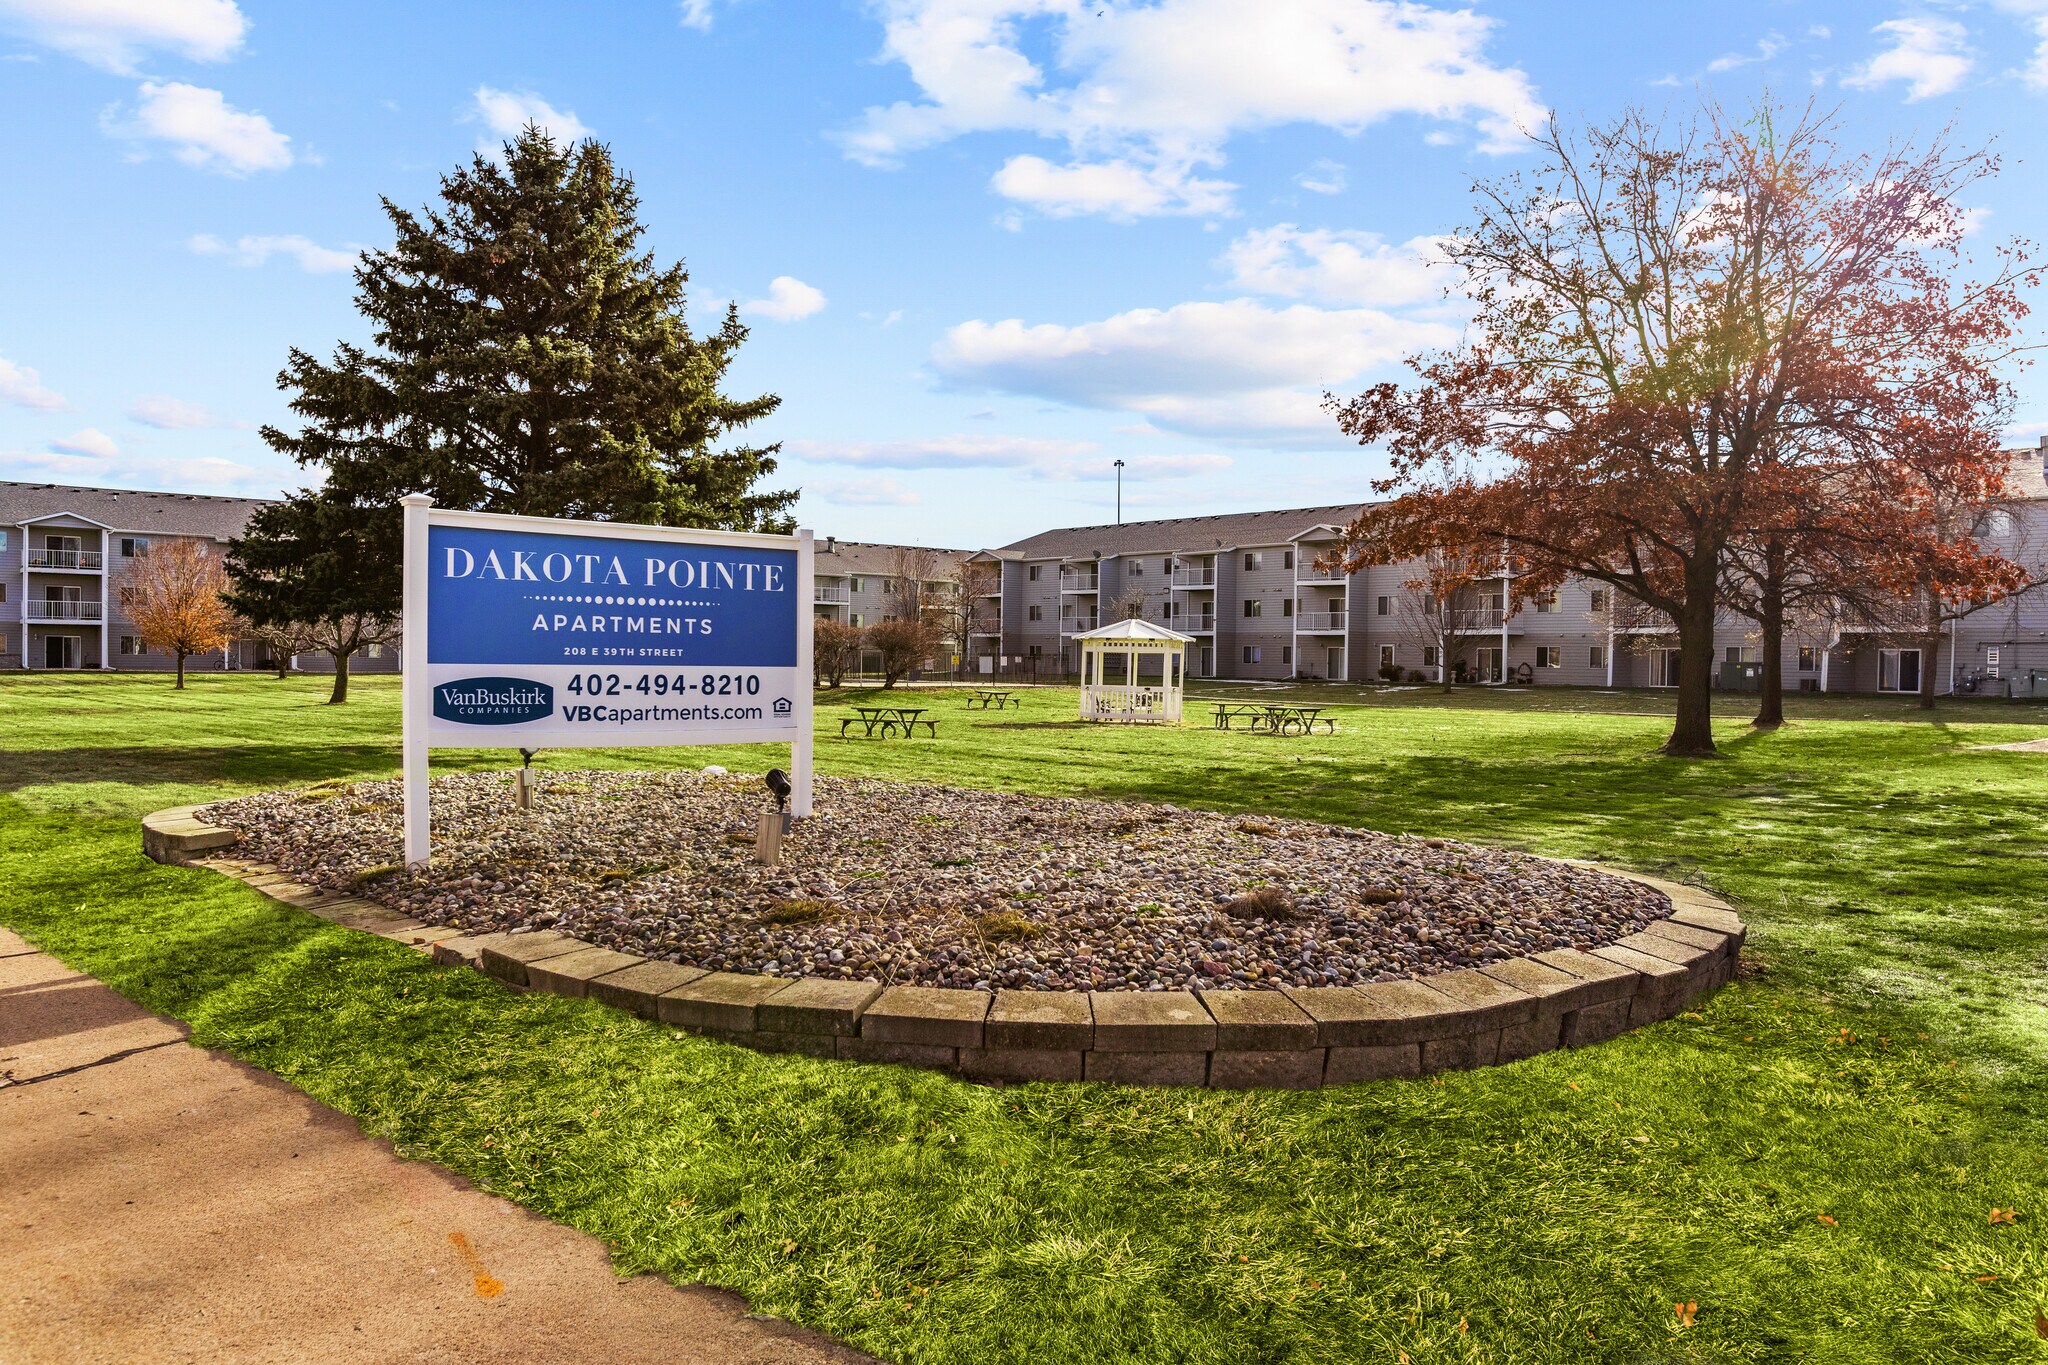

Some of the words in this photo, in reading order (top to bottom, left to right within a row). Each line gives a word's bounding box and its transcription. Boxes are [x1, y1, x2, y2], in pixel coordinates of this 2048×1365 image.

[443, 547, 631, 586] DAKOTA
[643, 557, 784, 592] POINTE
[532, 614, 713, 635] APARTMENTS
[564, 647, 587, 656] 208
[592, 647, 599, 656] E
[603, 647, 635, 656] 39TH
[639, 648, 684, 657] STREET
[567, 674, 761, 696] 402-494-8210
[441, 687, 547, 706] VanBuskirk
[459, 706, 530, 714] COMPANIES
[562, 704, 763, 725] VBCapartments.com
